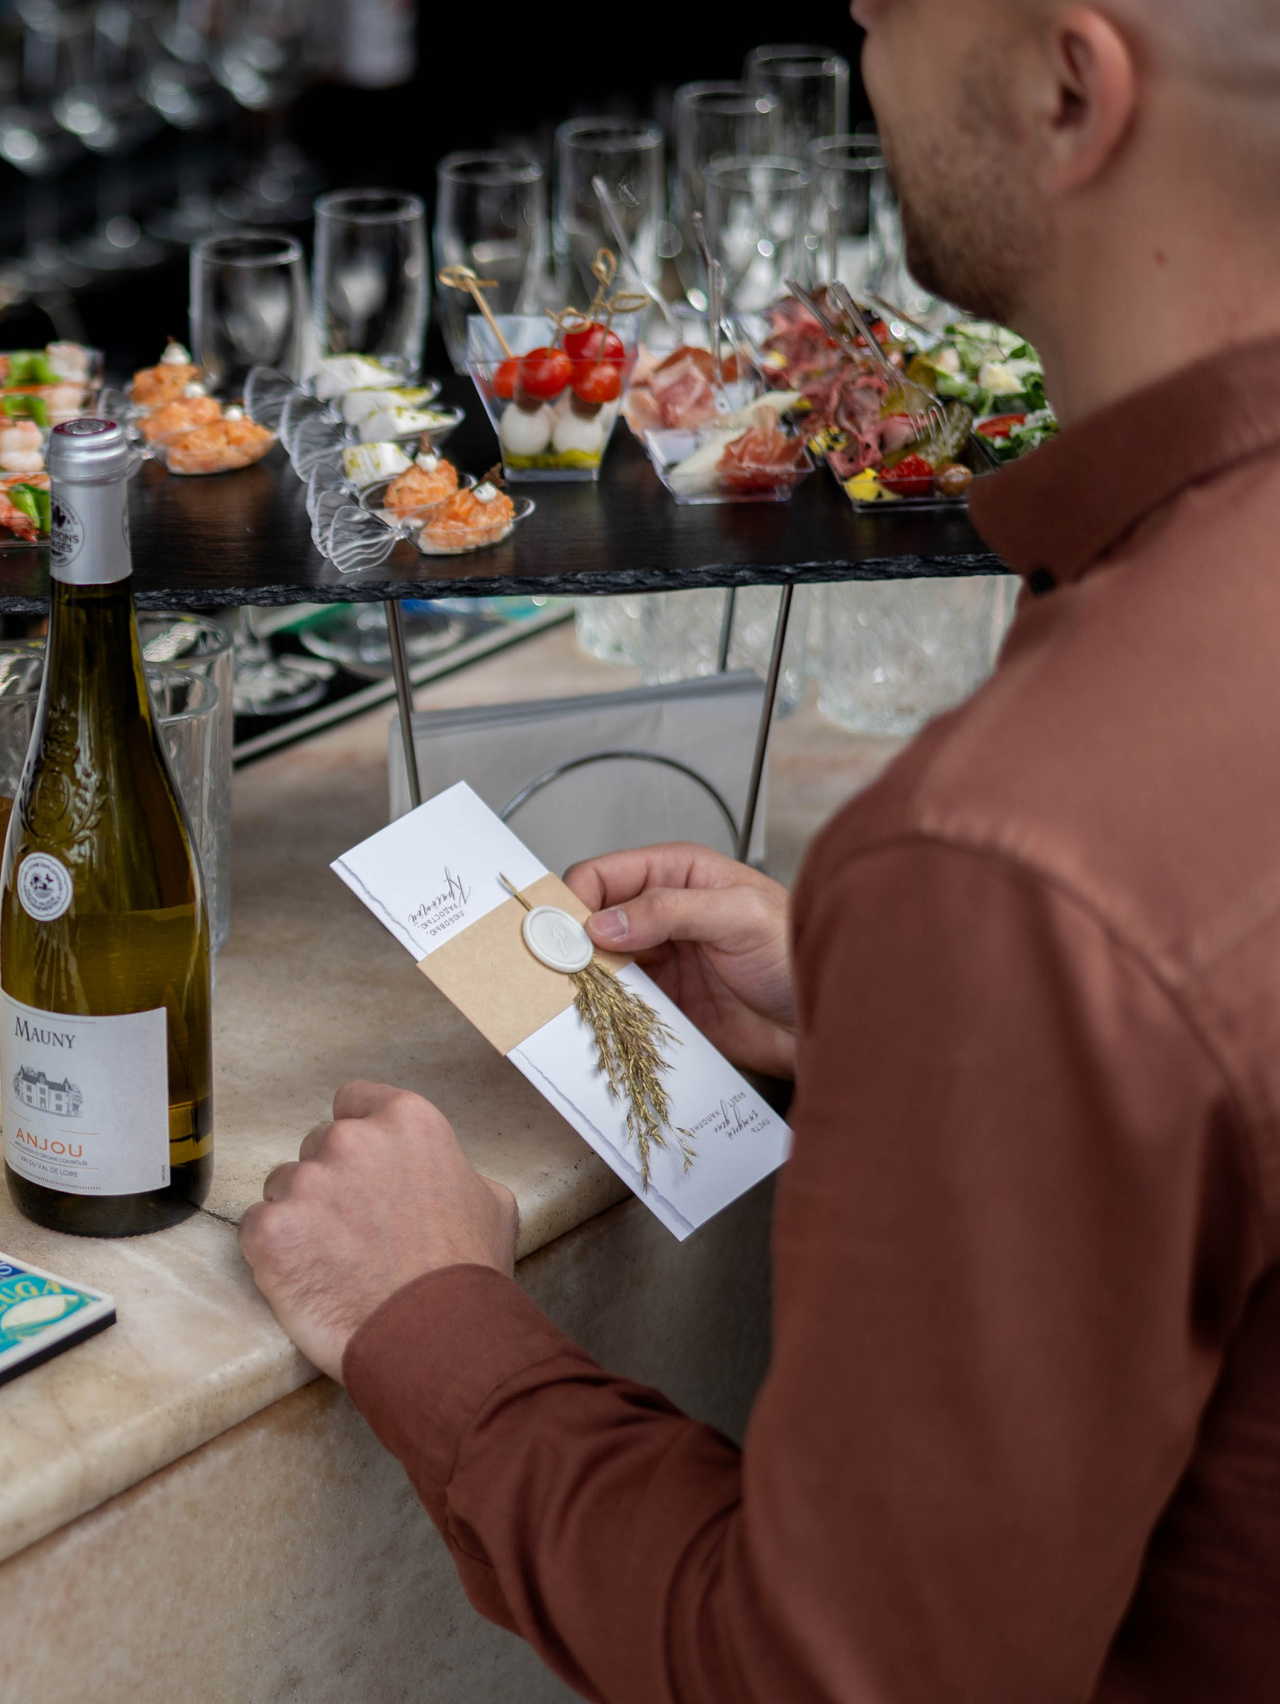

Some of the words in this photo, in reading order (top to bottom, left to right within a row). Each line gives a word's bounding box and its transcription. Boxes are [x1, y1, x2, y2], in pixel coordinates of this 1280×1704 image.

[417, 903, 458, 930] РАДОСТЬЮ,
[426, 910, 465, 936] ЛЮБОВЬЮ,
[689, 1109, 721, 1135] НАПОЛНЕ
[750, 1118, 771, 1133] ПУСТЬ
[16, 1127, 83, 1158] ANJOU
[37, 1162, 49, 1173] VAL
[49, 1166, 59, 1175] DE
[60, 1169, 79, 1178] LOIRE
